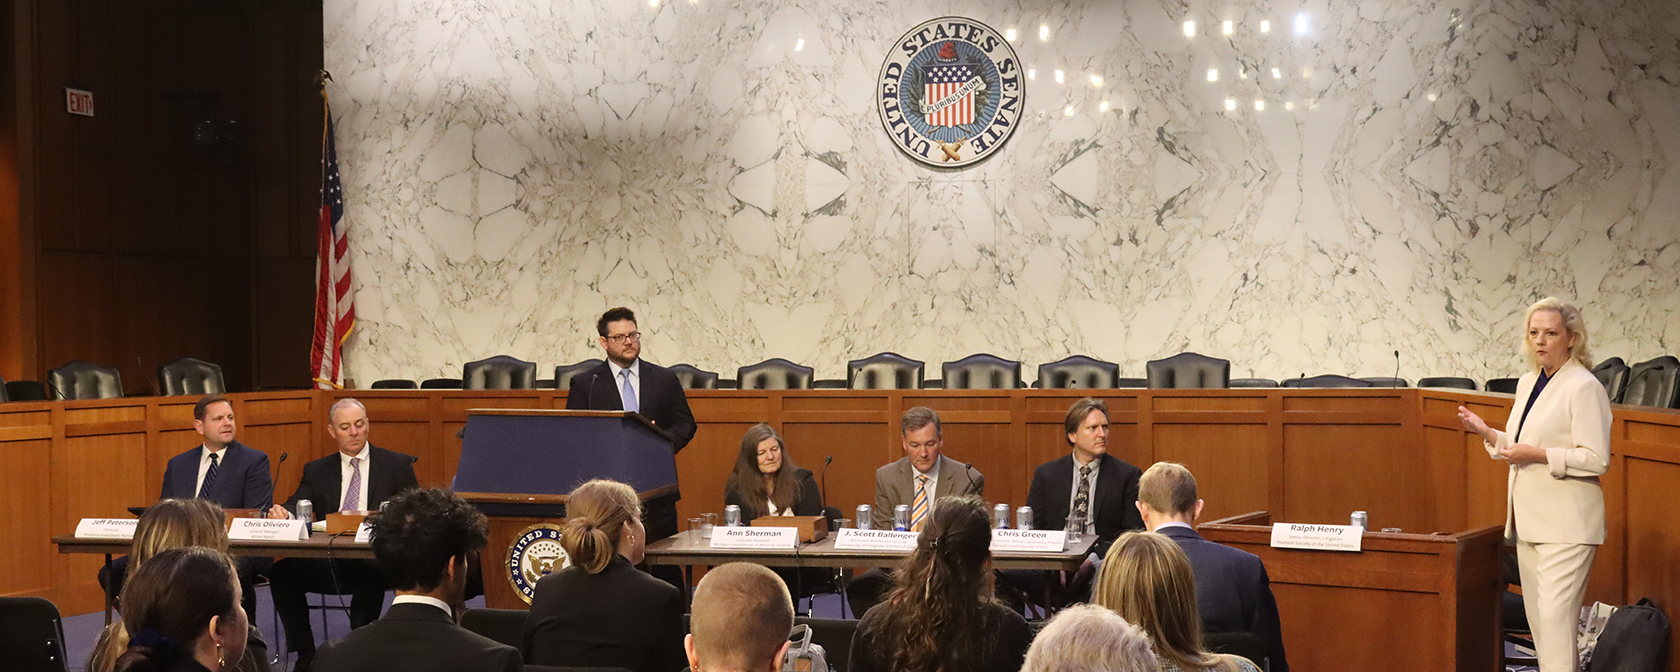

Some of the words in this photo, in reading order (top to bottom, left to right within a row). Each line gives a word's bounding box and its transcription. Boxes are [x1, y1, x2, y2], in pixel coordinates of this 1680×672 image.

[902, 22, 1000, 58] STATES
[70, 92, 89, 113] EXIT
[883, 62, 931, 158] UNITED
[926, 92, 961, 113] PLURIBUS
[959, 78, 980, 99] UNUM
[970, 58, 1019, 155] SENATE
[91, 518, 107, 526] Jeff
[877, 532, 917, 540] Ballenger
[1290, 524, 1315, 533] Ralph
[1317, 526, 1344, 535] Henry
[511, 530, 543, 567] UNITED
